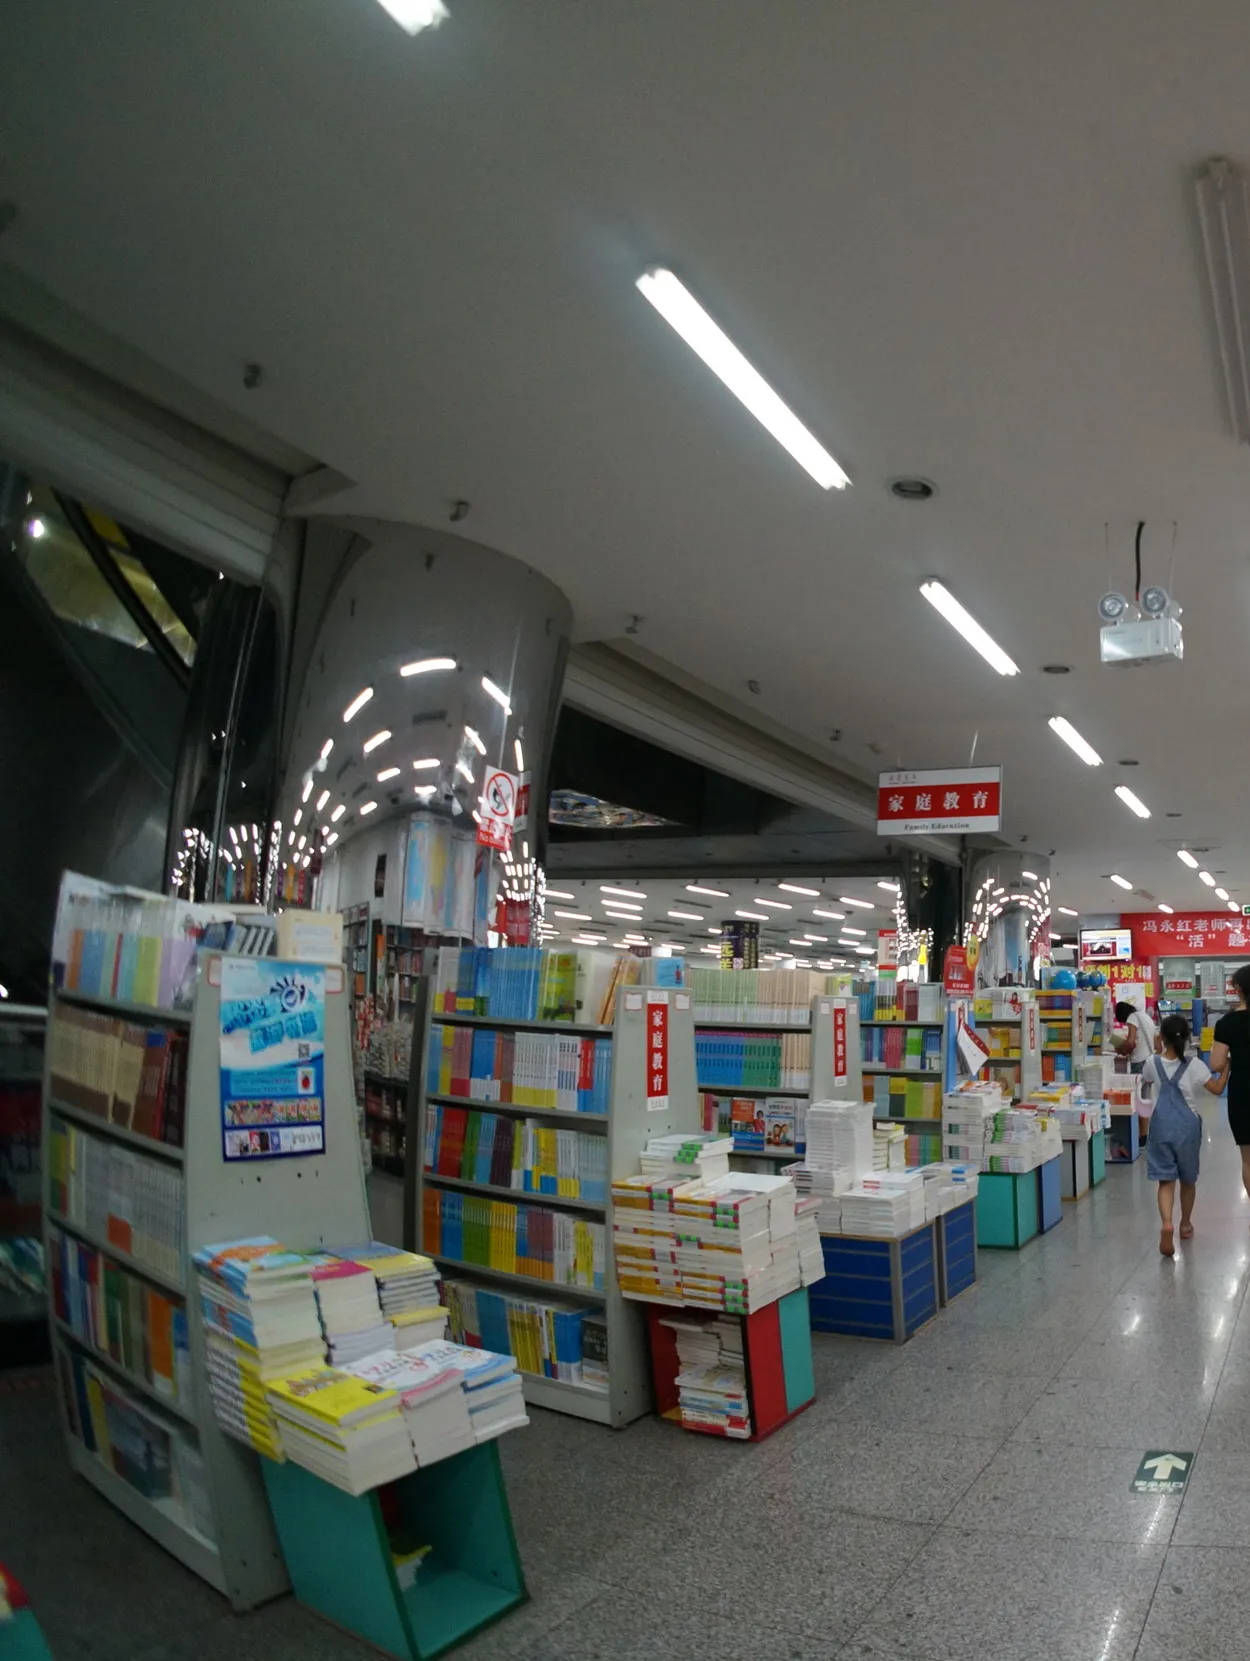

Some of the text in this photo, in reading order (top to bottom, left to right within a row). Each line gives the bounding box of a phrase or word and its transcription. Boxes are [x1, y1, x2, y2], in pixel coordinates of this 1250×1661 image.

[887, 790, 989, 812] 家庭教育
[652, 1009, 664, 1092] 家庭教育
